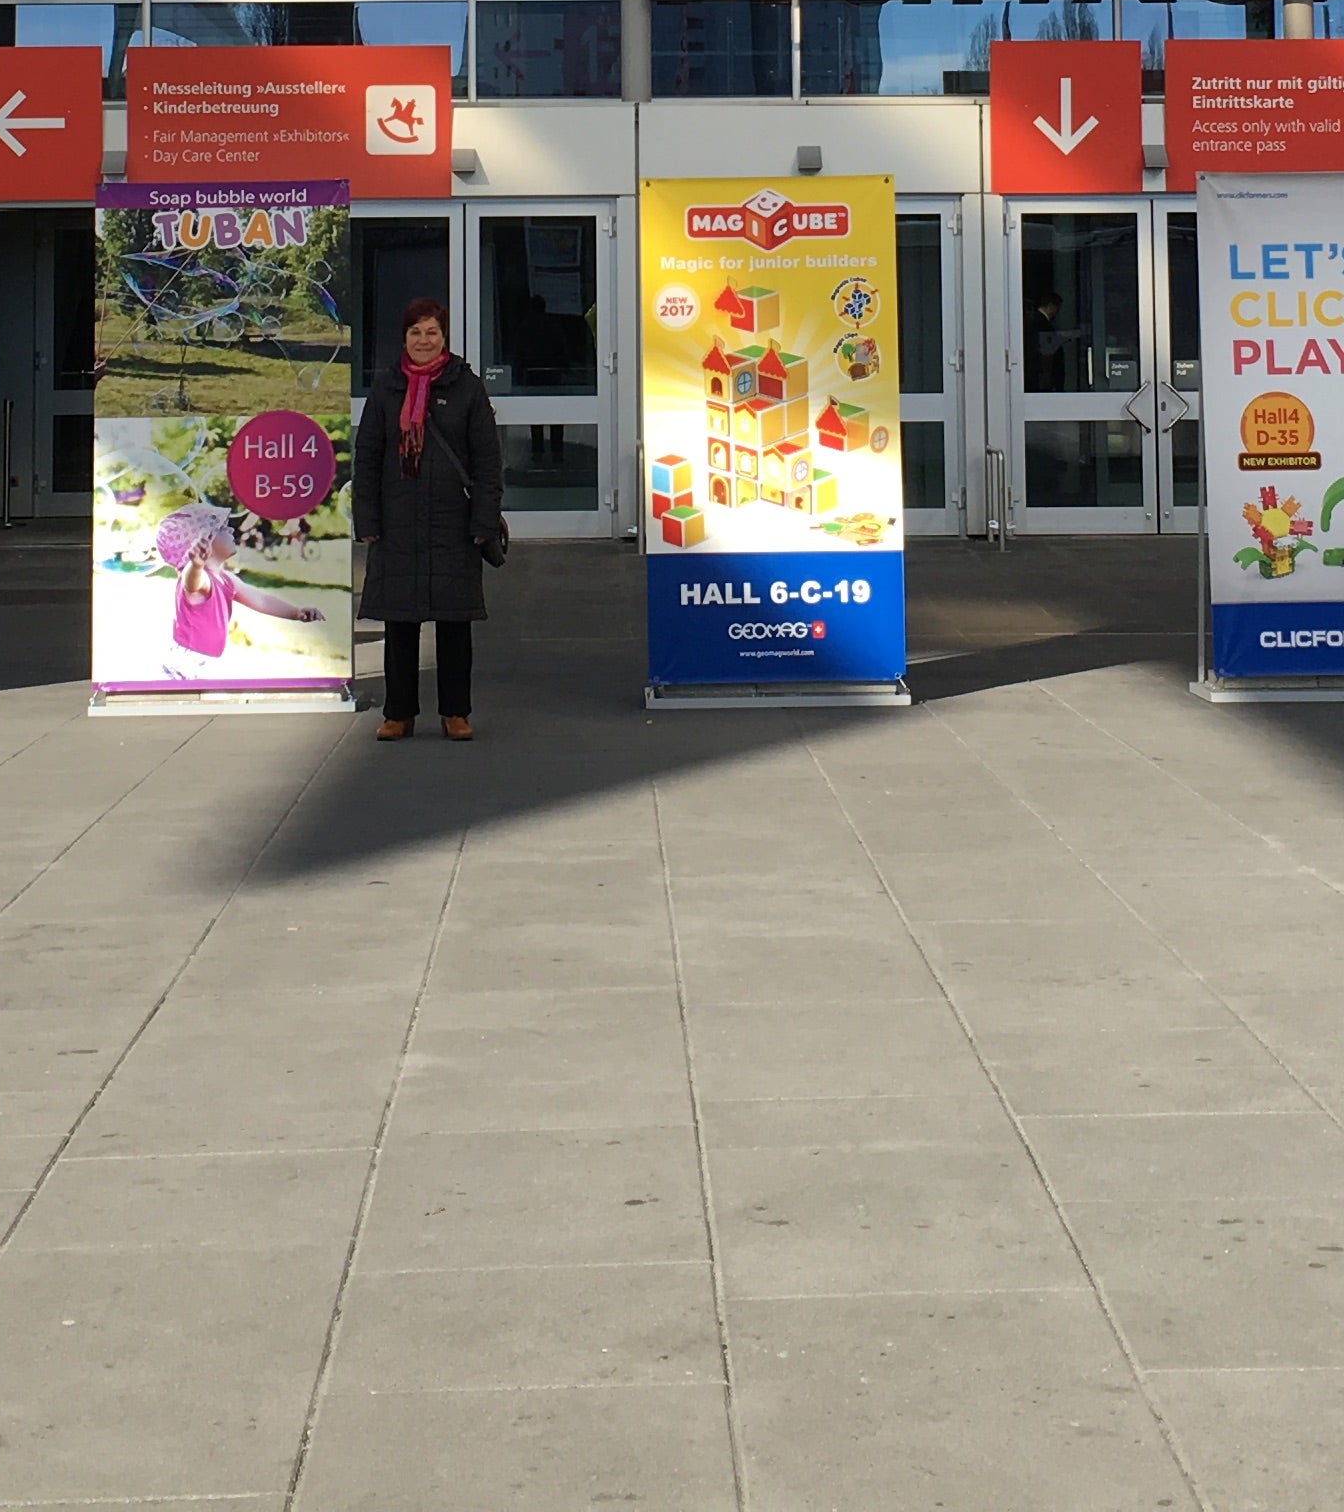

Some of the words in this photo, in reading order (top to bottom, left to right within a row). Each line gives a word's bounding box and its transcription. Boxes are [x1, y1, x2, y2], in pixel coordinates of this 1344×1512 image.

[153, 82, 252, 98] Messeleitung
[256, 81, 346, 95] »Aussteller«
[1192, 76, 1242, 90] Zutritt
[1246, 79, 1272, 90] nur
[1277, 76, 1303, 90] mit
[153, 101, 279, 117] Kinderbetreuung
[1192, 95, 1294, 109] Eintrittskarte
[1192, 120, 1238, 133] Access
[1241, 120, 1271, 136] only
[1274, 119, 1306, 133] with
[1309, 119, 1341, 133] valid
[153, 130, 176, 142] Fair
[180, 130, 269, 146] Management
[1192, 140, 1253, 152] entrance
[1256, 141, 1286, 154] pass
[153, 149, 178, 165] Day
[182, 149, 212, 163] Care
[216, 149, 260, 162] Center
[149, 190, 192, 208] Soap
[196, 189, 256, 203] bubble
[259, 189, 307, 203] world
[153, 209, 309, 250] TUBAN
[660, 255, 713, 272] Magic
[719, 256, 744, 269] for
[748, 255, 800, 272] junior
[805, 254, 878, 268] builders
[666, 296, 688, 304] NEW
[659, 305, 694, 317] 2017
[1256, 429, 1299, 446] D-35
[244, 435, 294, 459] Hall
[301, 435, 318, 458] 4
[1243, 457, 1266, 466] NEW
[1267, 456, 1317, 466] EXHIBITOR
[255, 474, 314, 498] B-59
[680, 582, 761, 606] HALL
[769, 579, 871, 604] 6-C-19
[728, 621, 809, 640] GEOMAG
